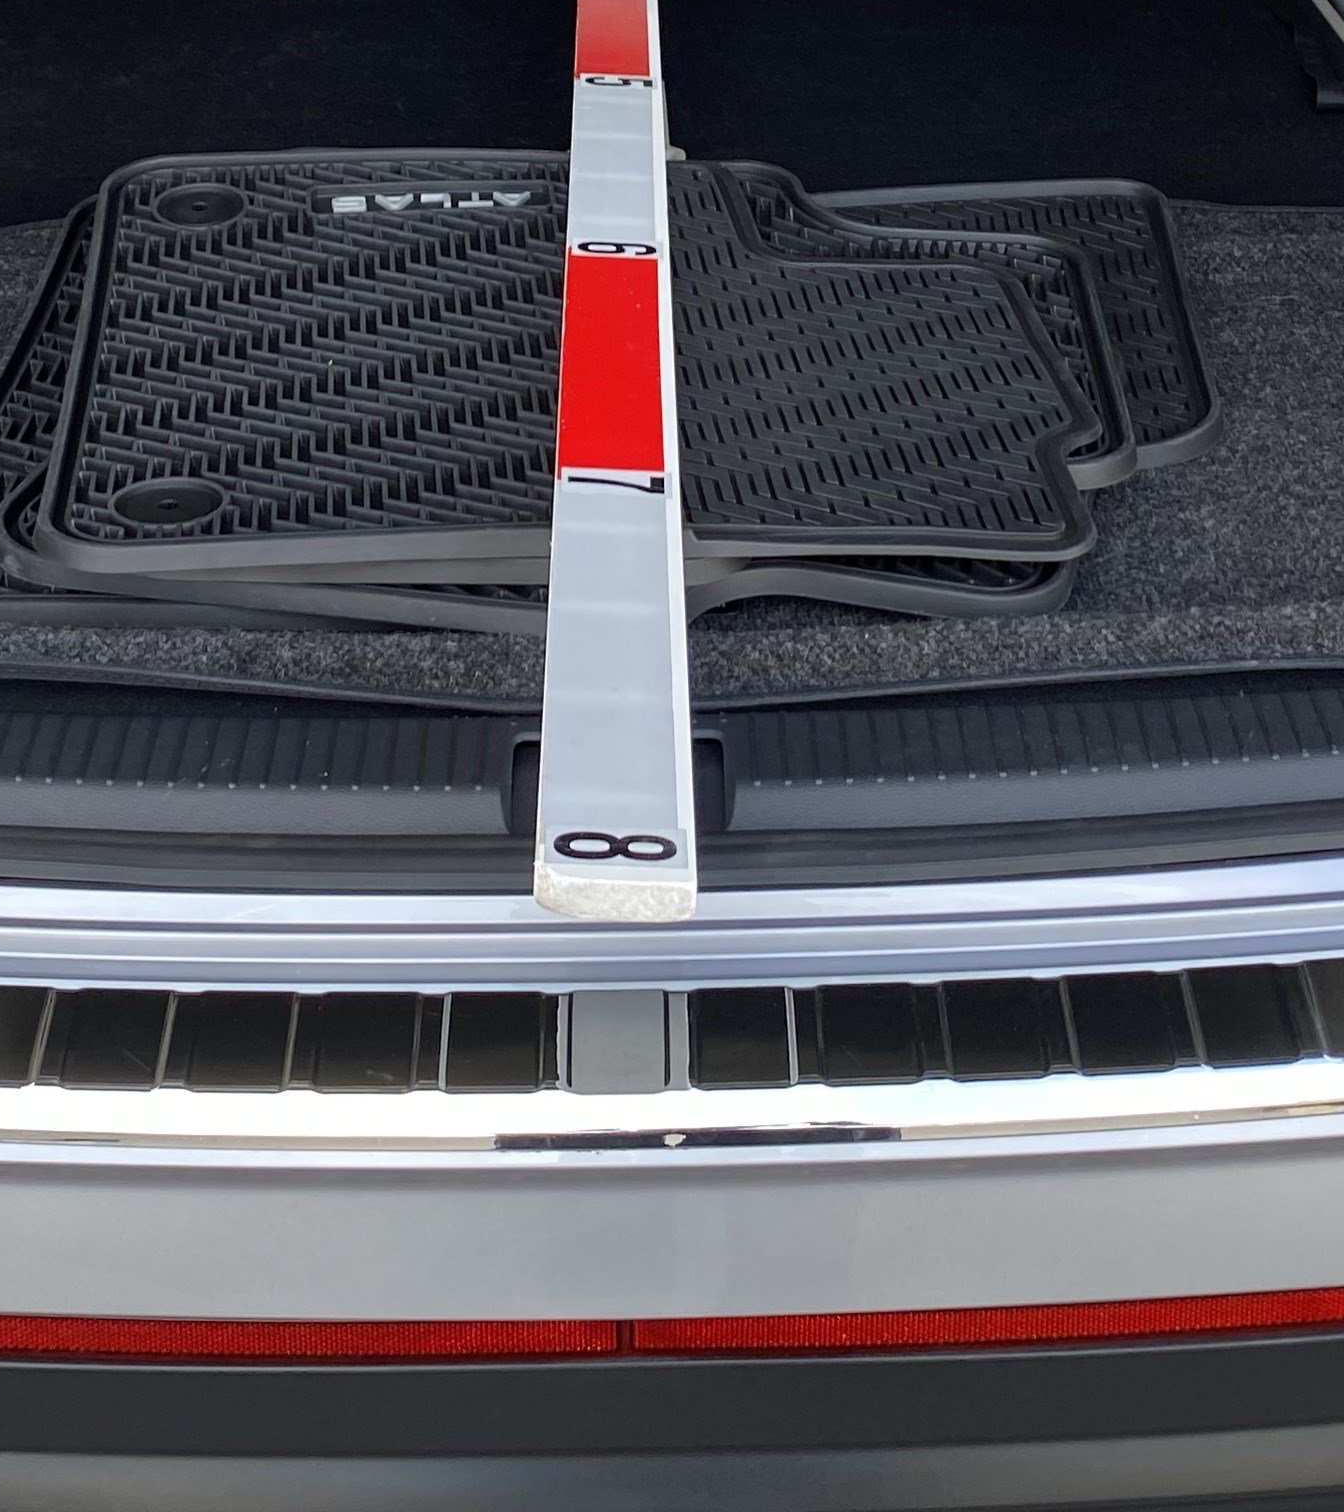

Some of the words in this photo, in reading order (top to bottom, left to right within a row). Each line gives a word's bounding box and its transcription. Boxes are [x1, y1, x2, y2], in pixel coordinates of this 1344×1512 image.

[585, 76, 653, 88] 5
[331, 190, 532, 214] ATLAS
[577, 241, 657, 256] 6
[568, 475, 665, 495] 7
[553, 831, 677, 861] 8
